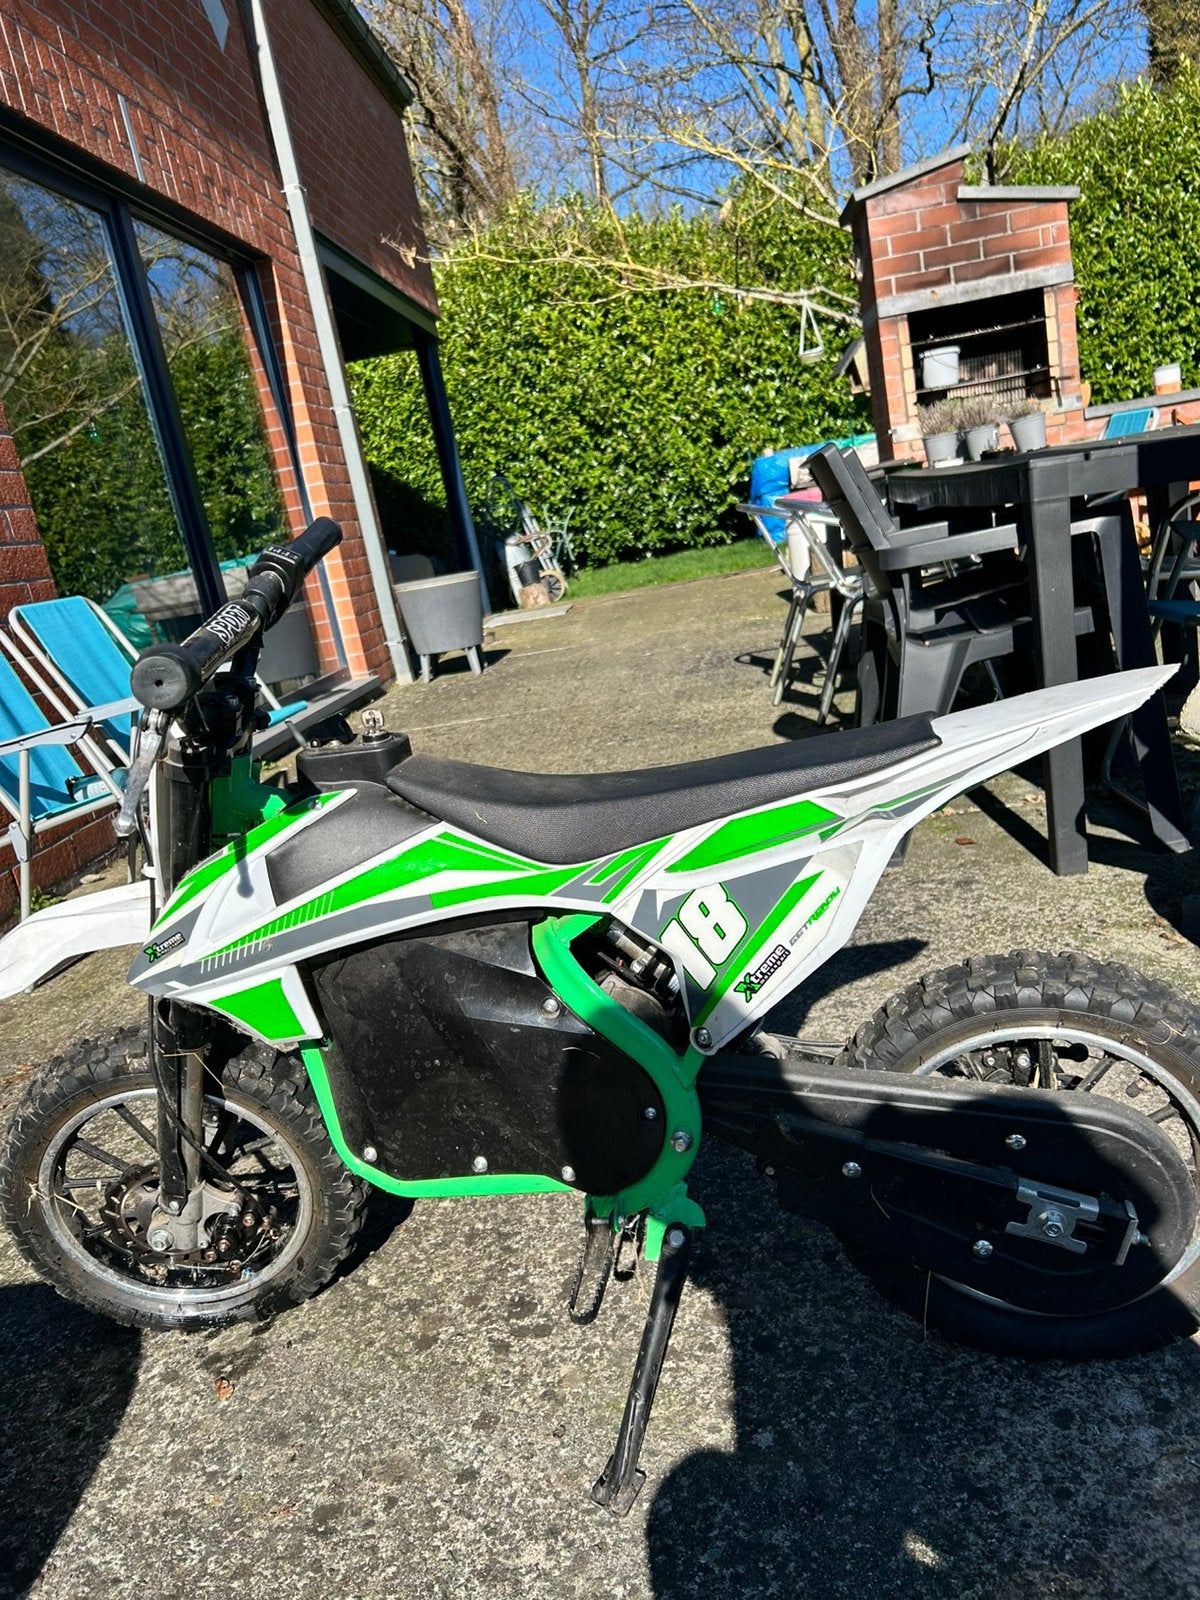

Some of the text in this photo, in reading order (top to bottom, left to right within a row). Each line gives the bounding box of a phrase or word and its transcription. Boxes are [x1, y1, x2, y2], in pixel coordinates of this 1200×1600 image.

[206, 604, 250, 644] SPORT
[143, 932, 183, 963] Xtreme
[658, 881, 749, 992] 18
[734, 944, 787, 1003] Xtreme
